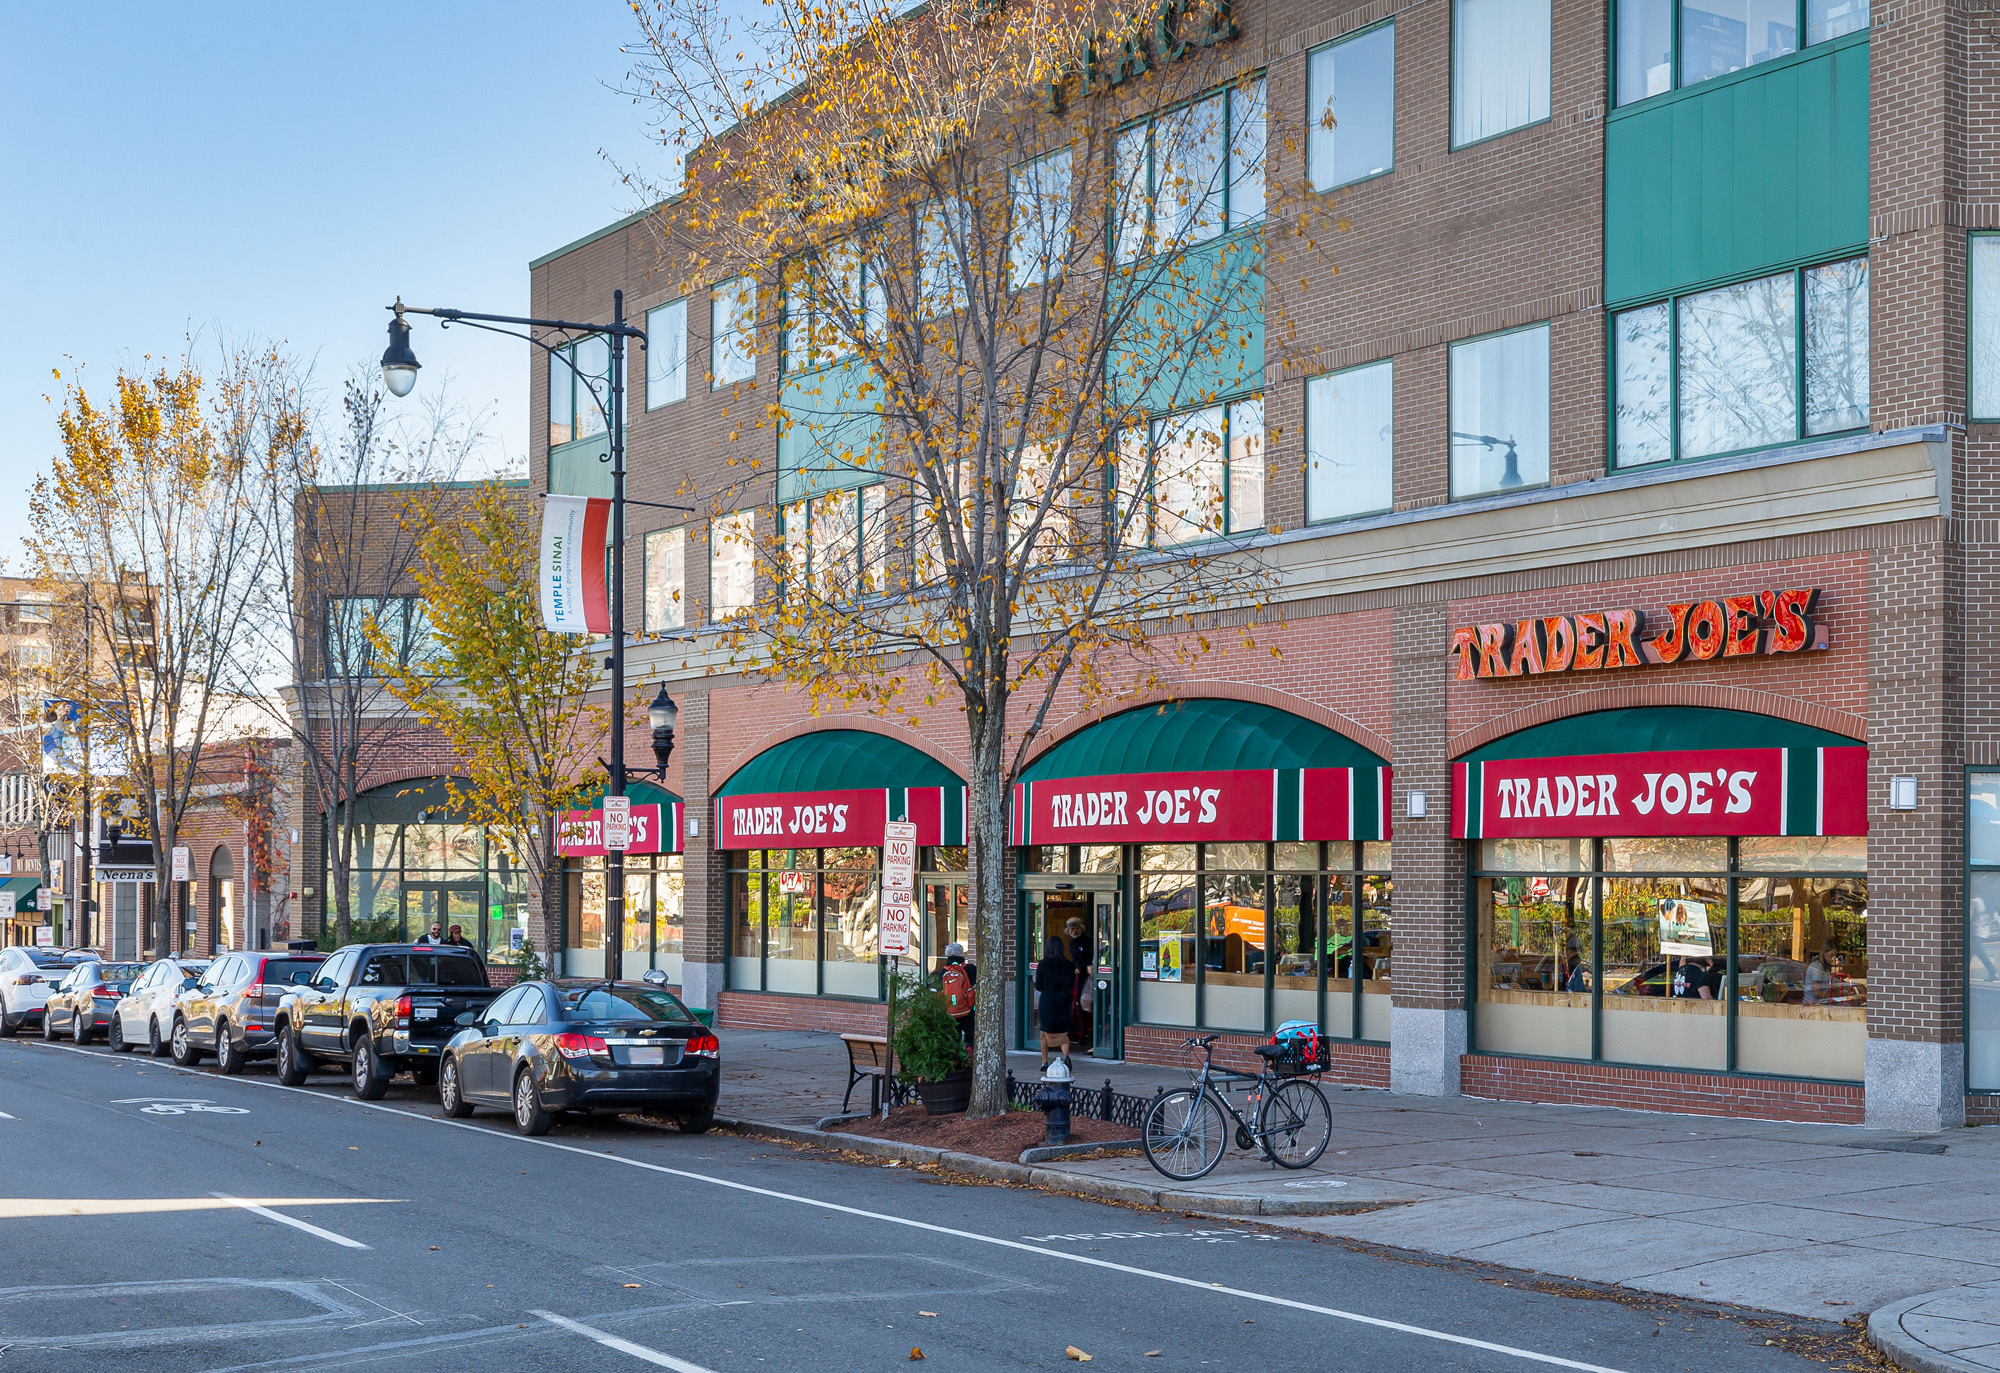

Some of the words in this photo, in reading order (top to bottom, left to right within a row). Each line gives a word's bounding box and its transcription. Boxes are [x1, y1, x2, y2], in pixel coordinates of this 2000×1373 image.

[567, 509, 576, 545] community
[552, 536, 563, 572] SINAI
[552, 575, 566, 622] TEMPLE
[1450, 609, 1644, 680] TRADER
[1649, 587, 1817, 663] JOE'S
[1498, 775, 1619, 818] TRADER
[1632, 769, 1757, 814] JOE'S
[610, 812, 623, 823] NO
[1051, 790, 1128, 827] TRADER
[1136, 787, 1220, 824] JOE'S
[606, 823, 626, 831] PARKING
[733, 805, 783, 835] TRADER
[789, 803, 848, 834] JOE'S
[892, 843, 907, 855] NO
[887, 855, 911, 866] PARKING
[101, 870, 153, 880] Neena's
[887, 909, 905, 921] NO
[883, 923, 907, 933] PARKING
